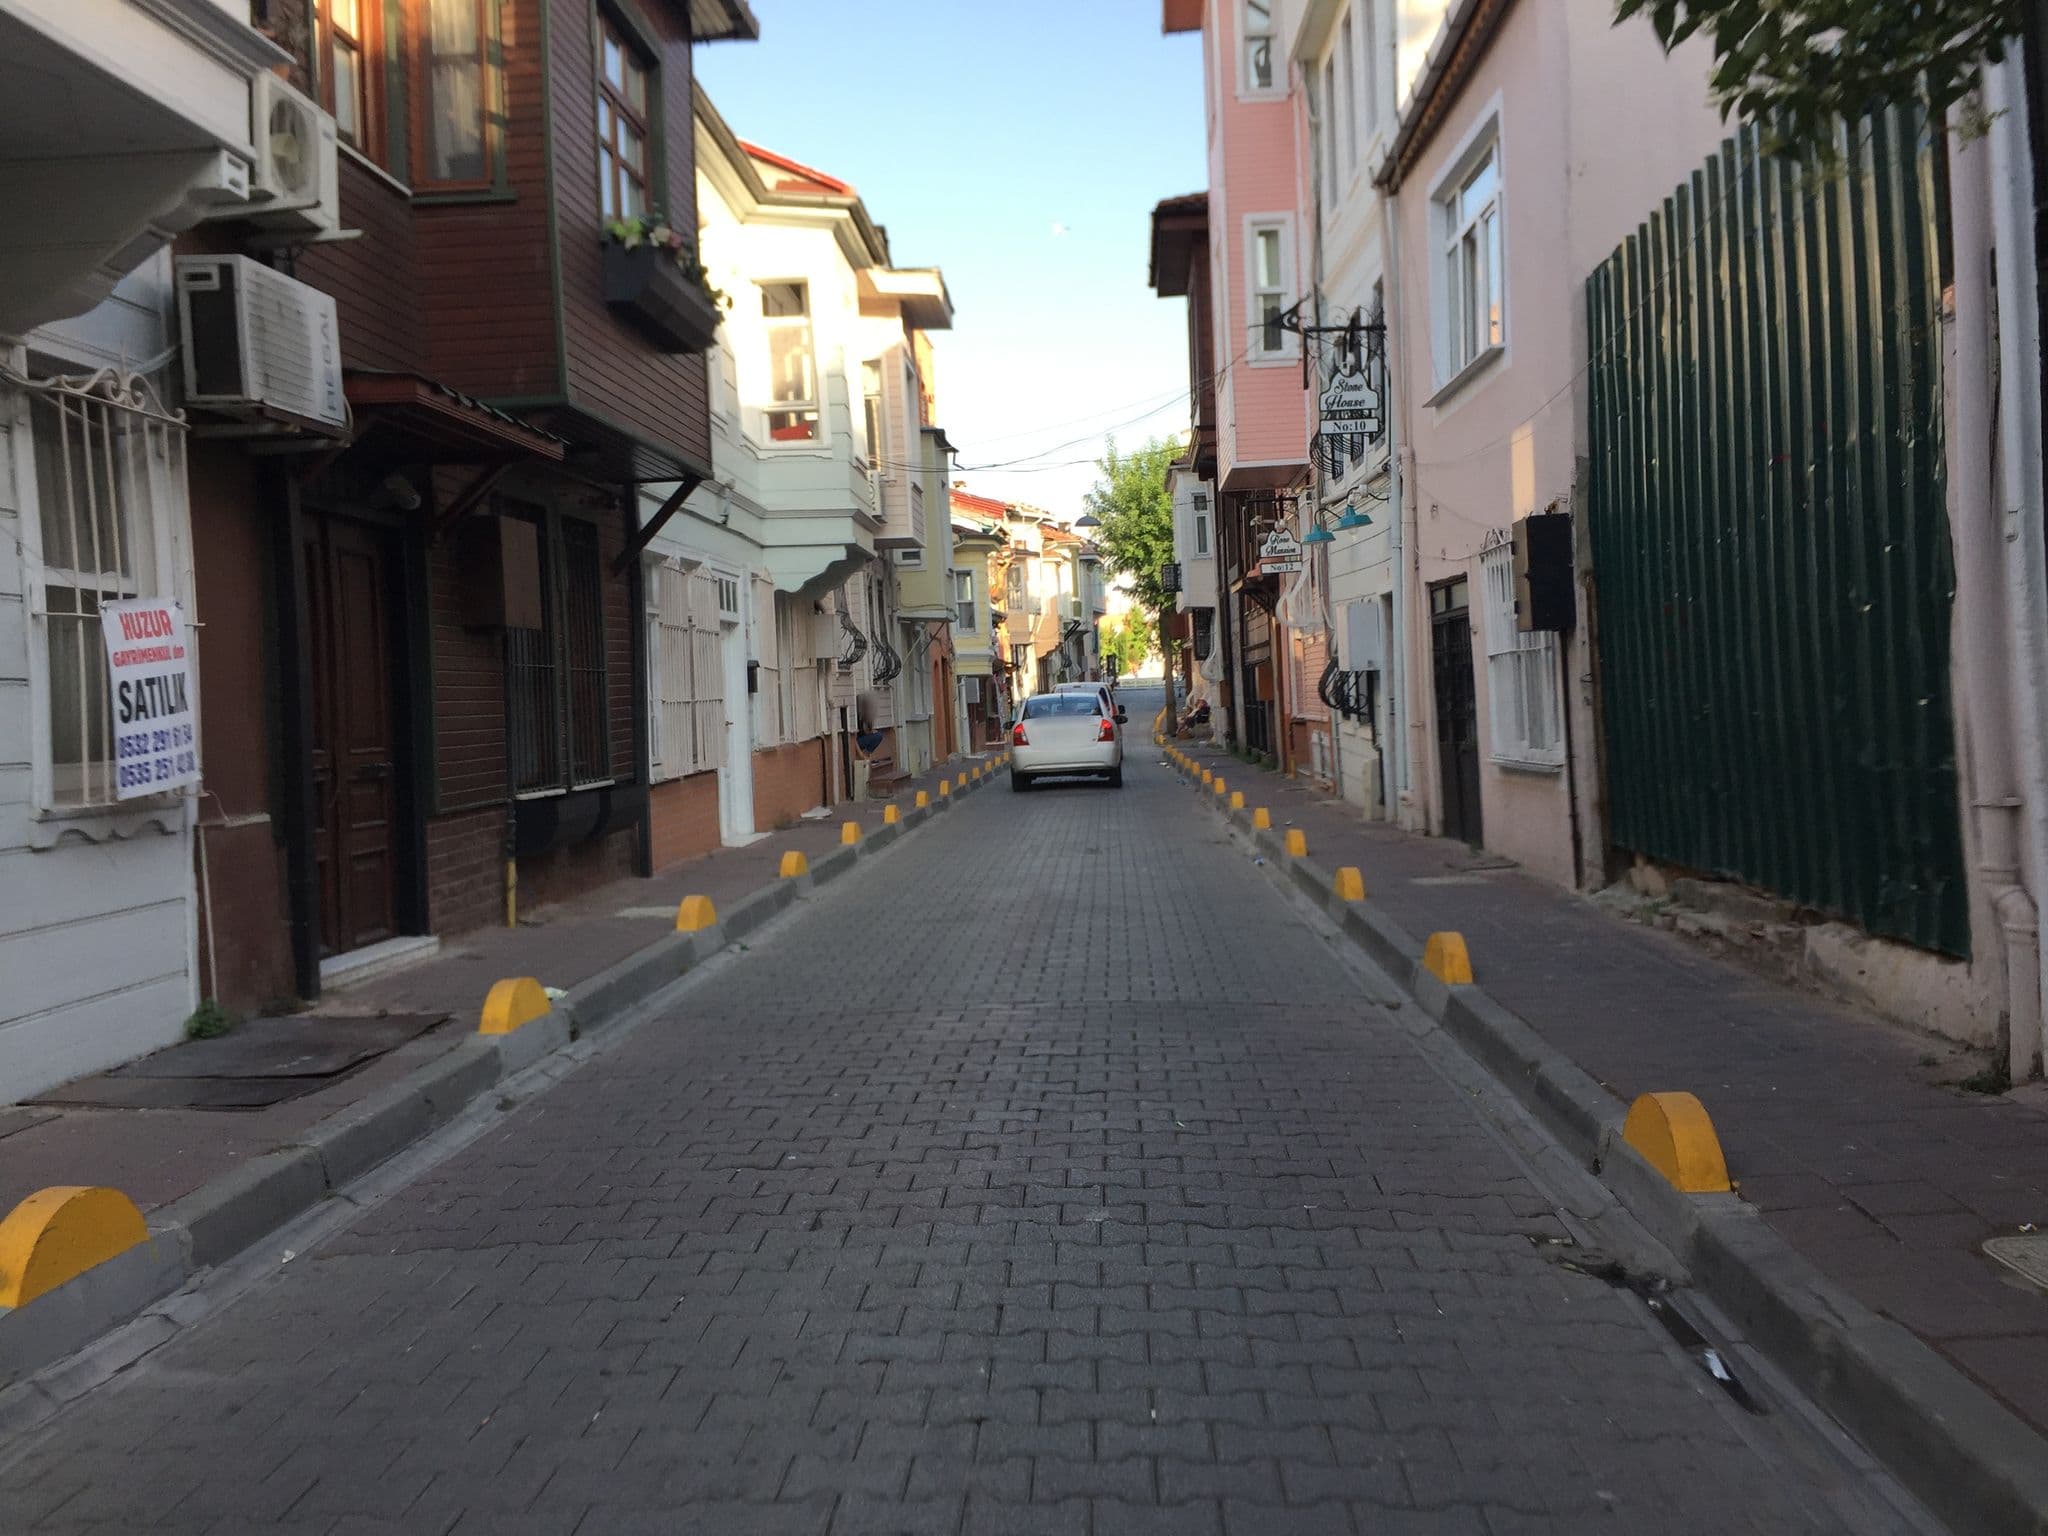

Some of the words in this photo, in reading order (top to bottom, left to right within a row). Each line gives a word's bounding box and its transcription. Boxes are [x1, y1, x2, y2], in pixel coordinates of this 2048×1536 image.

[1334, 379, 1363, 394] Stone
[1325, 395, 1366, 410] House
[1333, 421, 1366, 432] No:10
[119, 609, 173, 640] HUZUR
[119, 672, 188, 723] SATILIK
